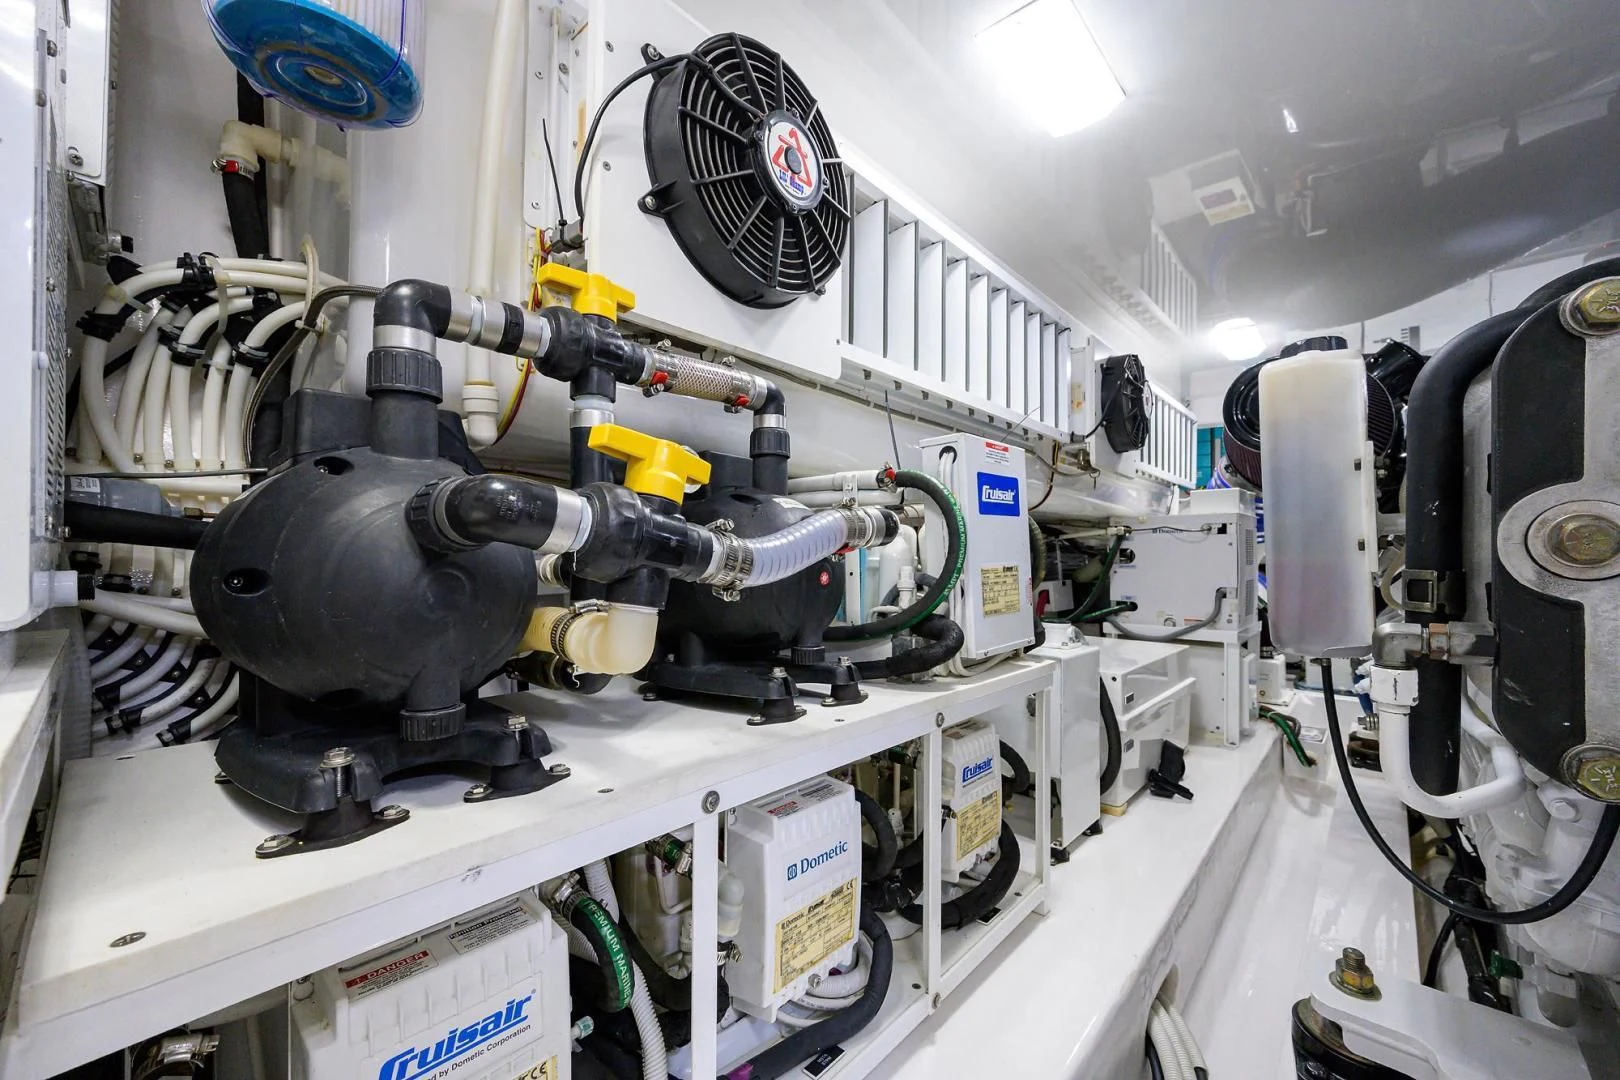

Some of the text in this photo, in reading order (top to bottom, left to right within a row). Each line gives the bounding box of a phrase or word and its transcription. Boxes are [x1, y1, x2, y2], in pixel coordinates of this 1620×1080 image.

[982, 485, 1015, 504] Cruisair
[962, 757, 993, 783] Cruisair
[800, 841, 848, 875] Dometic
[367, 952, 425, 979] DANGER
[584, 901, 620, 951] PREMIUM
[617, 953, 632, 998] MARINE
[378, 994, 532, 1080] Cruisair
[439, 1024, 531, 1078] by Dometic Corporation
